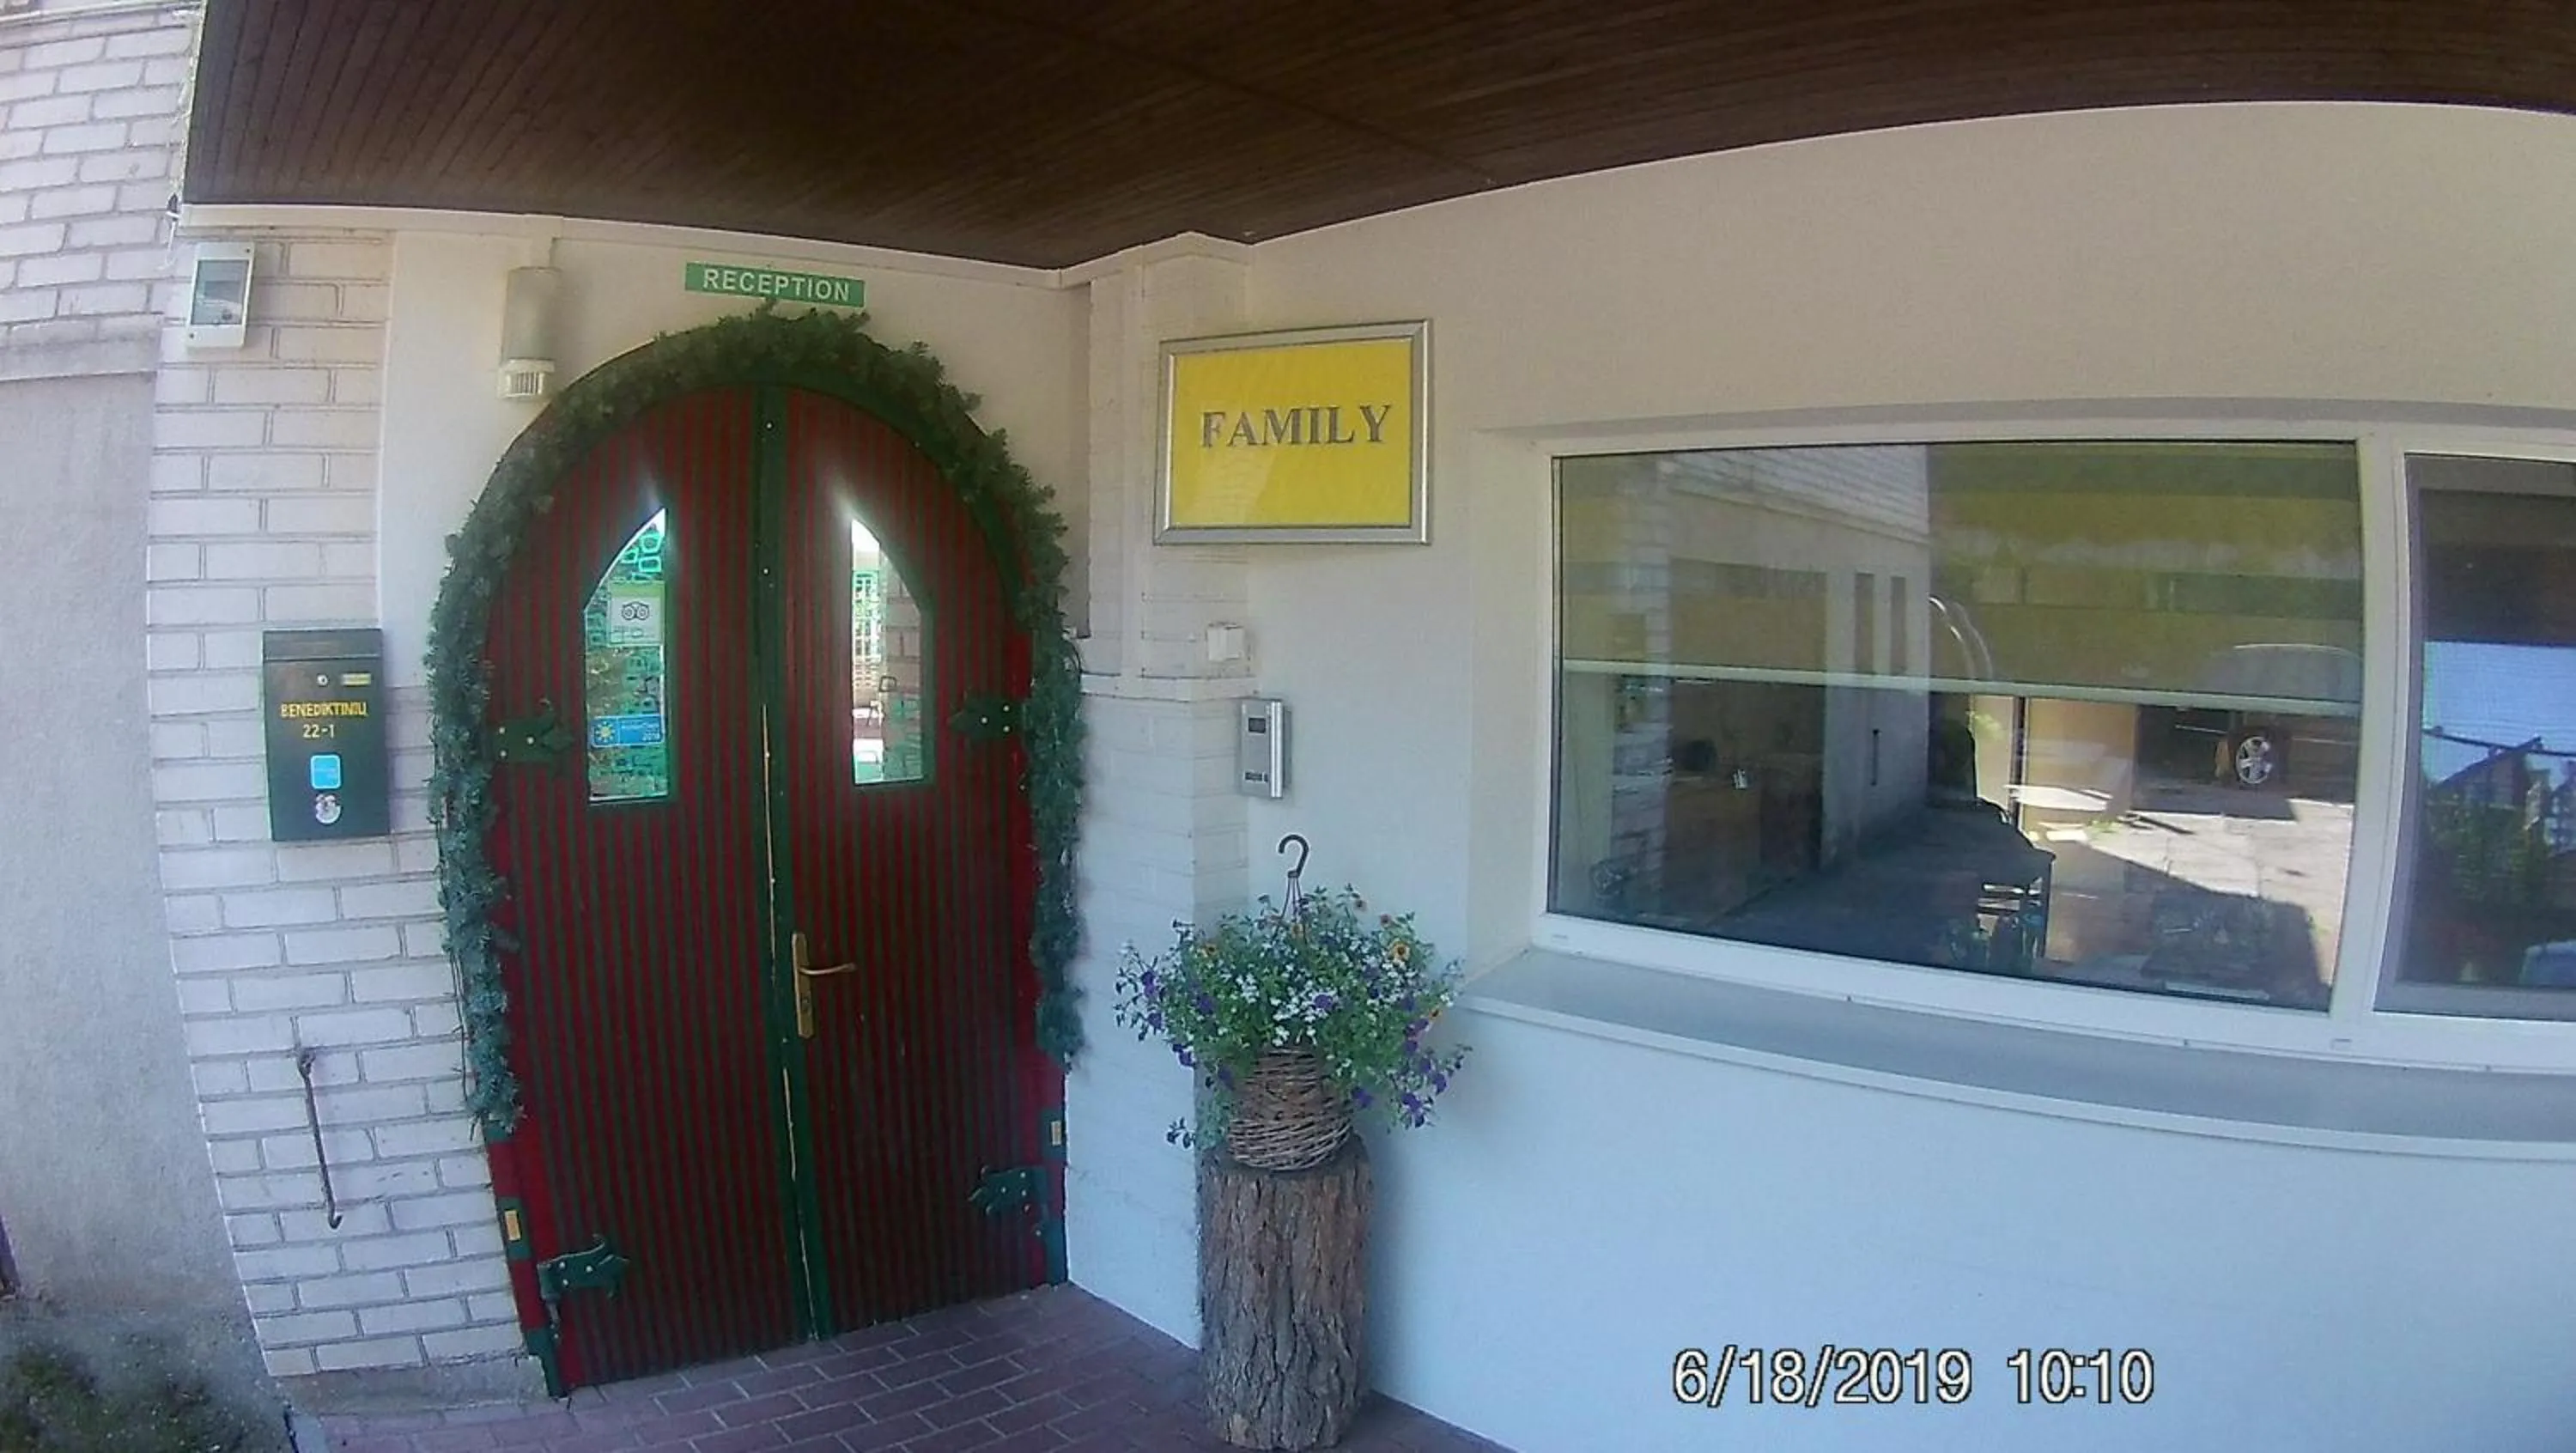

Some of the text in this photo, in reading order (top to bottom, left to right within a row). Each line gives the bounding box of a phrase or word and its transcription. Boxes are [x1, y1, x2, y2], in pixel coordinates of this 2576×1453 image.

[703, 268, 850, 301] RECEPTION
[1200, 404, 1392, 447] FAMILY
[302, 724, 334, 739] 22-1
